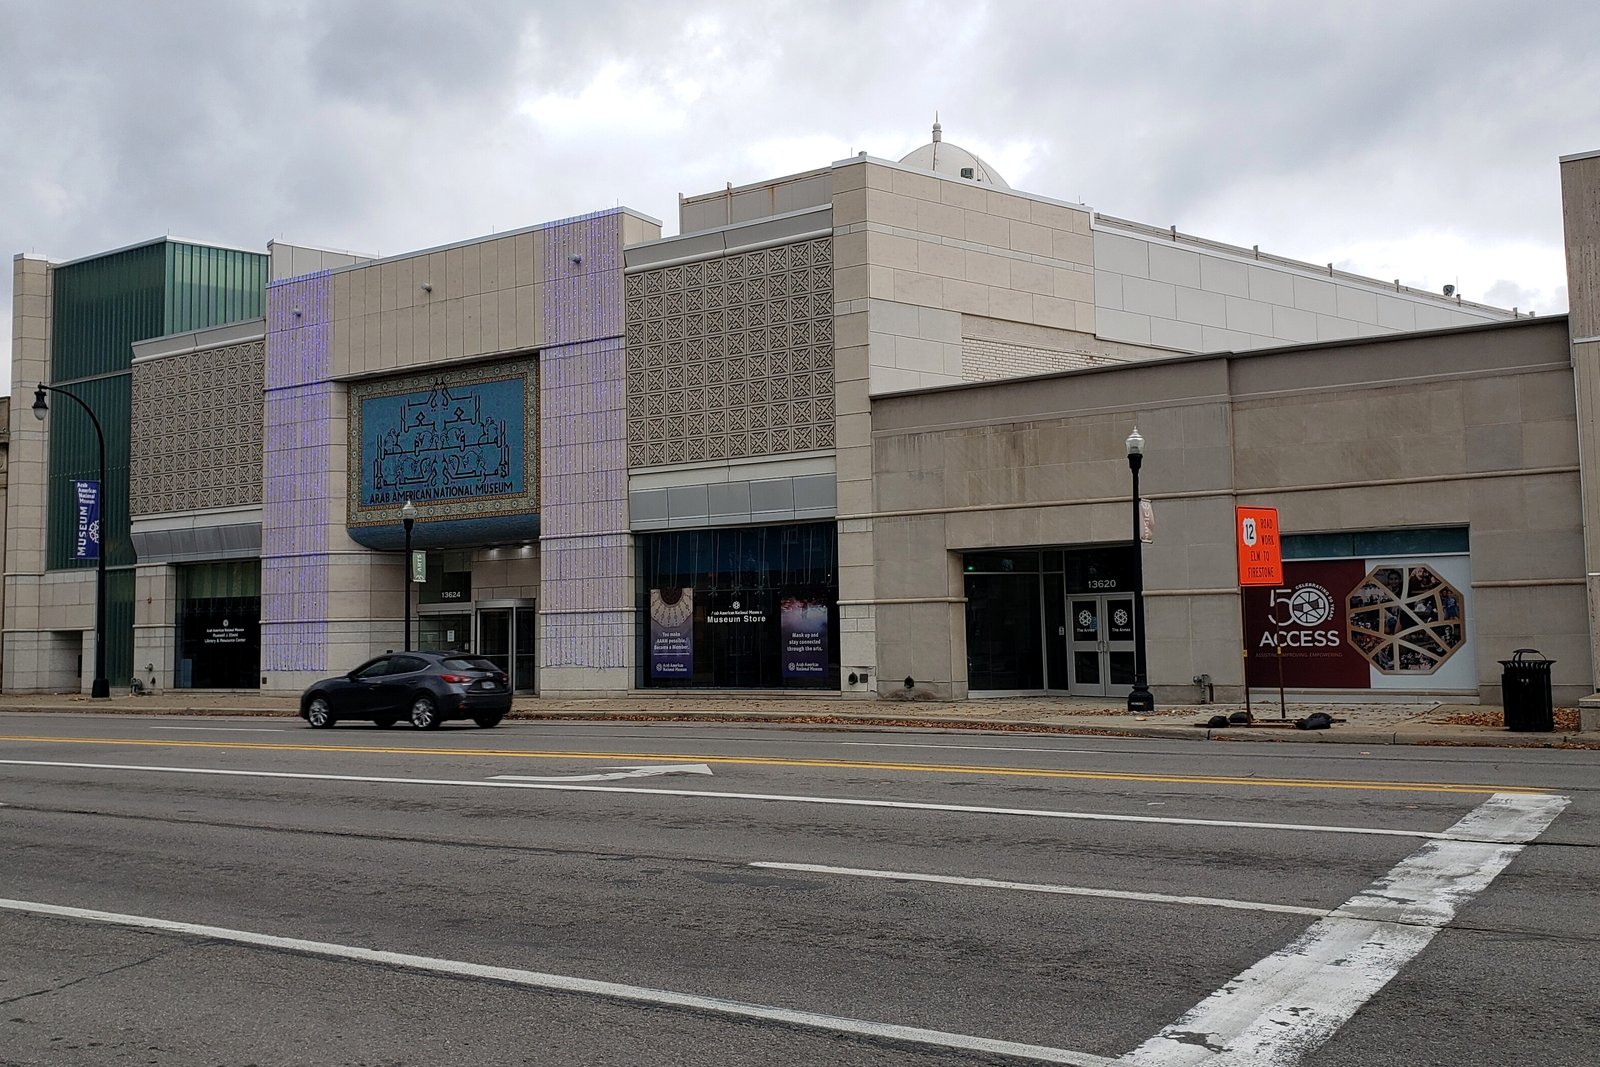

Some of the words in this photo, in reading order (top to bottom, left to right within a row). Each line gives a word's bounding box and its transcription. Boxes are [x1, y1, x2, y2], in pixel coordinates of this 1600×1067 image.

[370, 493, 390, 504] ARAB
[392, 488, 432, 502] AMERICAN
[433, 484, 474, 499] NATIONAL
[475, 481, 513, 496] MUSEUM
[77, 506, 88, 556] MUSEUM
[1260, 518, 1273, 529] ROAD
[1245, 523, 1254, 540] 12
[1250, 551, 1261, 561] ELM
[1263, 551, 1270, 561] TO
[1248, 566, 1275, 578] FIRESTONE
[1088, 579, 1116, 588] 13620
[1295, 582, 1330, 597] CELEBRATING
[1259, 630, 1340, 647] ACCESS
